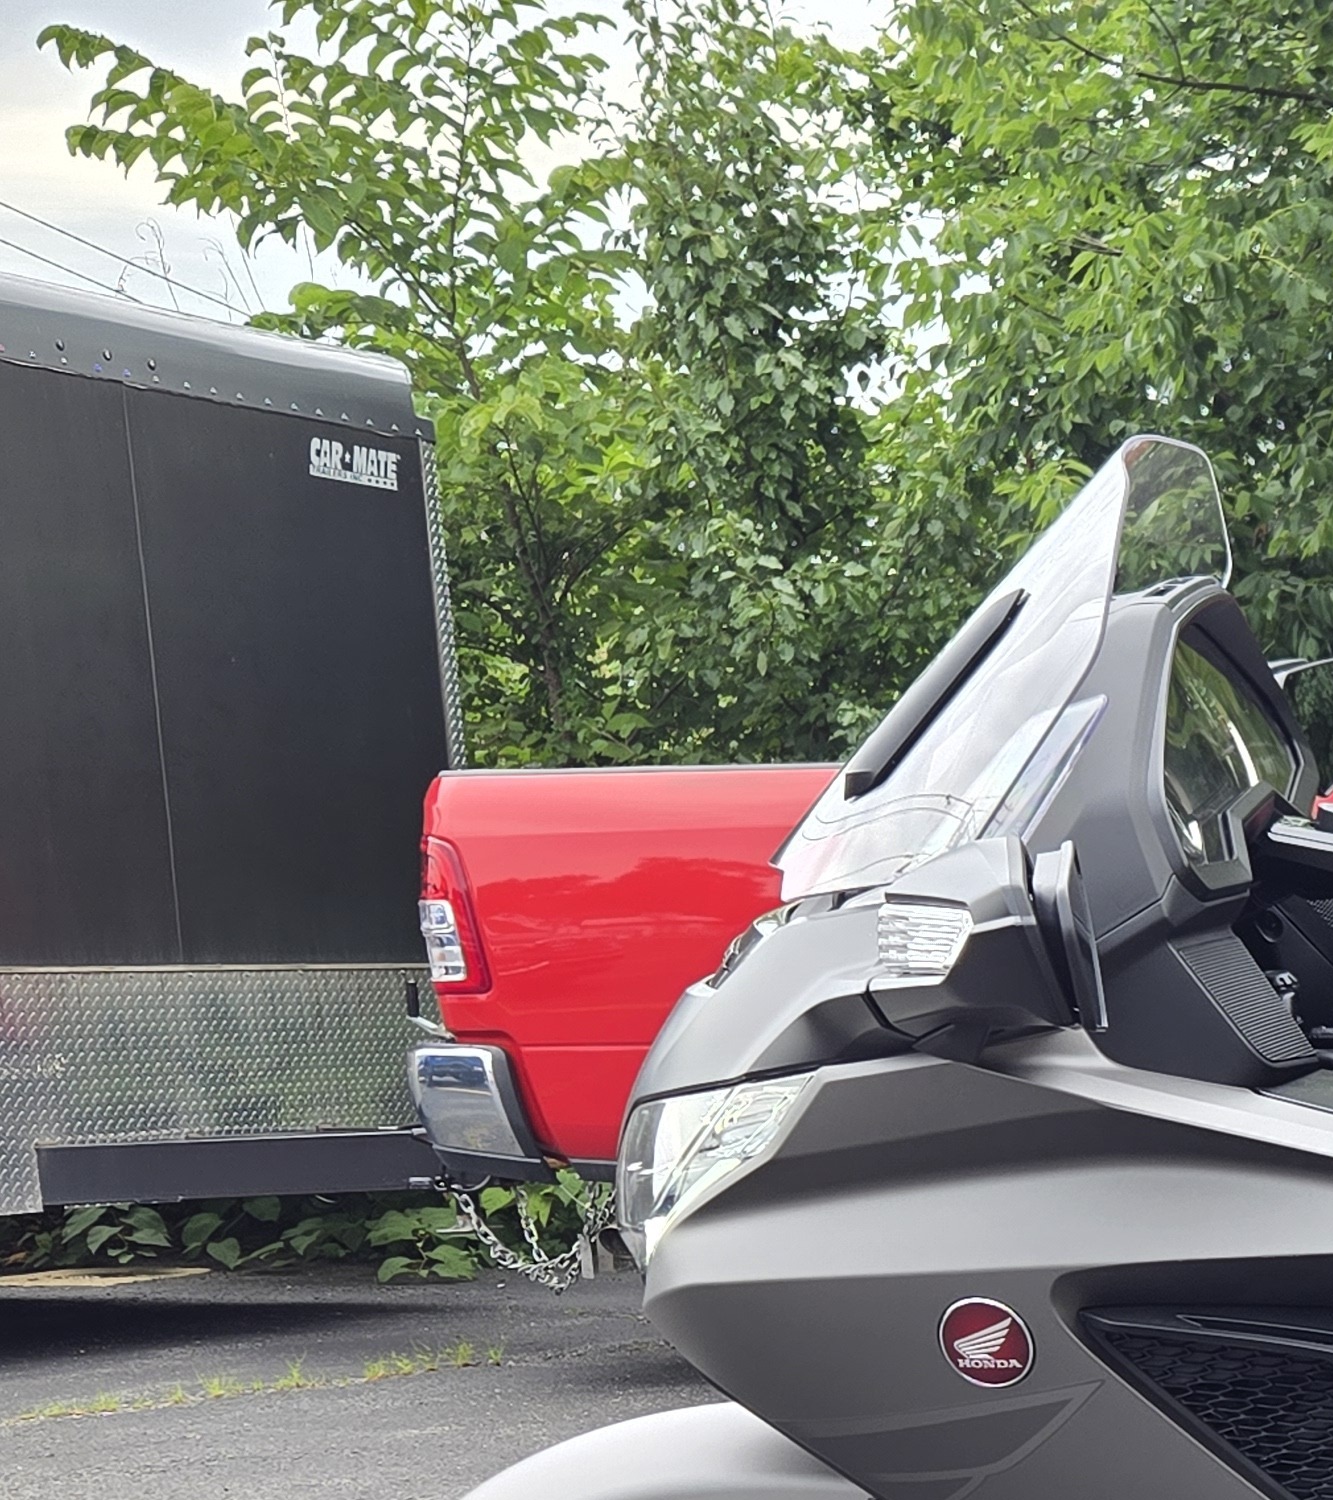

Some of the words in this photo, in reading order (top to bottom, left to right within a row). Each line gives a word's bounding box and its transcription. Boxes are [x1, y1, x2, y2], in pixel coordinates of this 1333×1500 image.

[310, 437, 344, 471] CAR
[353, 445, 398, 480] MATE
[957, 1358, 1024, 1369] HONDA
